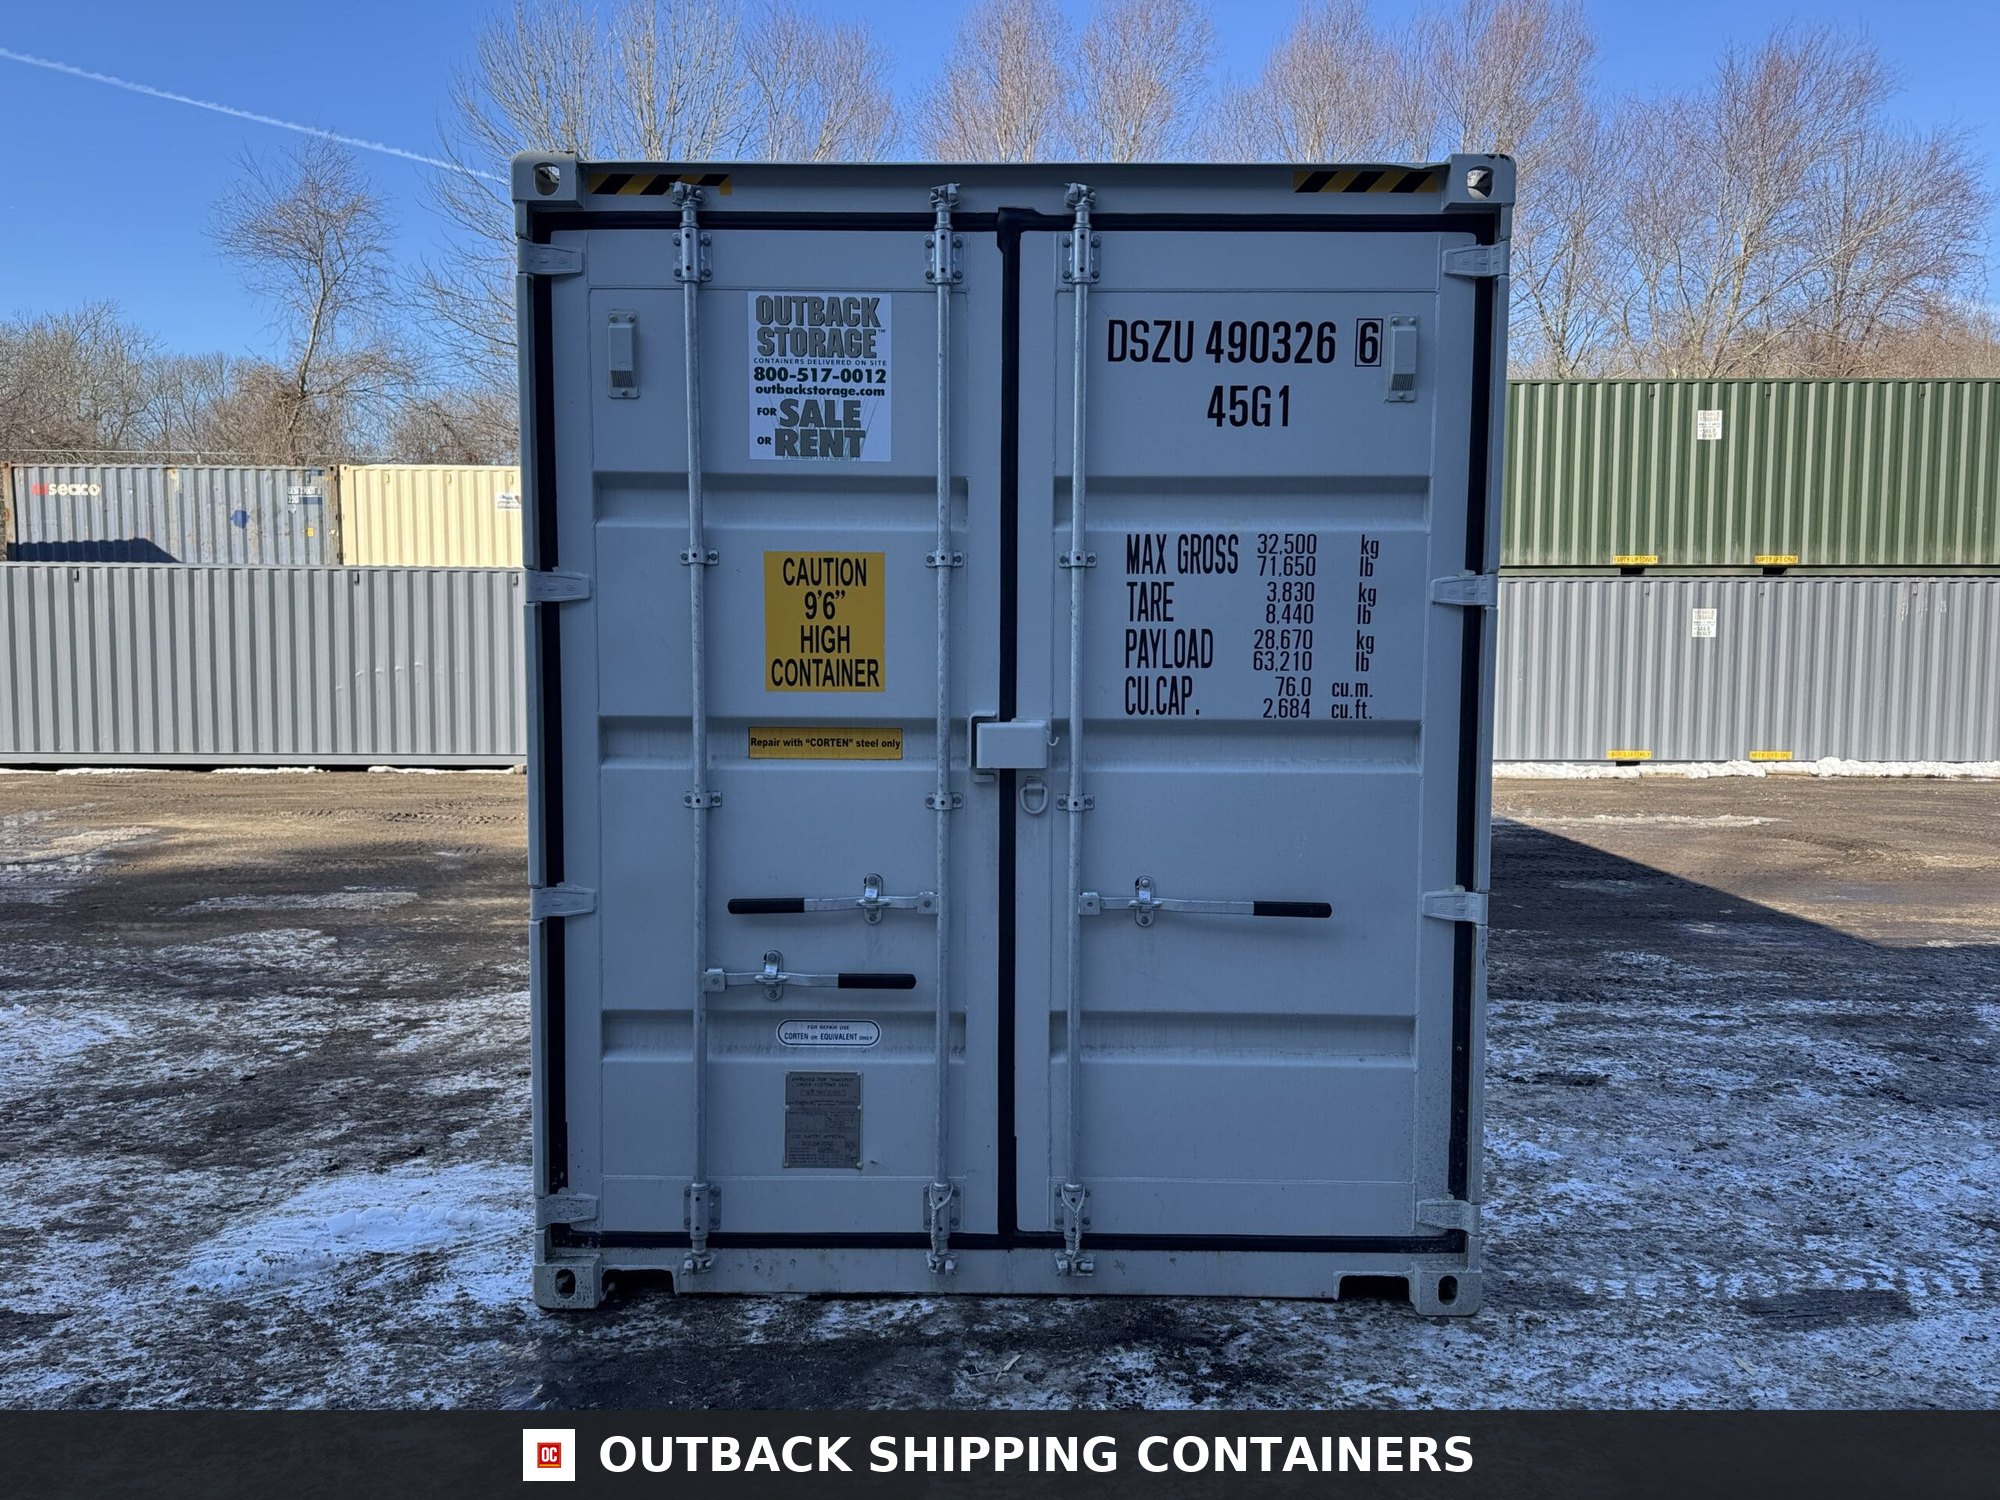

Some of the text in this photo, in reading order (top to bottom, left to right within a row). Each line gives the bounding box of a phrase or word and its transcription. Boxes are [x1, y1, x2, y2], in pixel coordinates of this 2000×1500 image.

[756, 295, 881, 328] OUTBACK
[1107, 319, 1379, 364] DSZU 490326 6
[753, 366, 887, 384] 800-517-0012
[807, 358, 852, 366] DELIVERED
[755, 384, 885, 398] outbackstorage.com
[757, 398, 862, 428] FOR SALE
[1207, 385, 1290, 427] 45G1
[757, 428, 866, 458] OR RENT
[48, 483, 101, 497] seaco
[1126, 533, 1239, 575] MAX GROSS
[1257, 533, 1379, 560] 32,500 kg
[783, 557, 867, 587] CAUTION
[1258, 556, 1374, 578] 71,650 lb
[1126, 581, 1175, 622] TARE
[1266, 581, 1376, 608] 3,830 kg
[1265, 604, 1372, 625] 8,440 lb
[800, 625, 850, 654] HIGH
[1125, 628, 1214, 669] PAYLOAD
[1254, 629, 1375, 654] 28,670 kg
[771, 658, 880, 687] CONTAINER
[1253, 650, 1370, 673] 63,210 lb
[1275, 676, 1373, 698] 76.0 cu.m.
[1263, 698, 1373, 720] 2,684 cu.ft.
[750, 737, 780, 748] Repair
[783, 738, 803, 747] with
[856, 738, 879, 748] steel
[881, 738, 901, 750] only
[784, 1032, 808, 1040] CORTEN
[820, 1033, 858, 1041] EQUIVALENT
